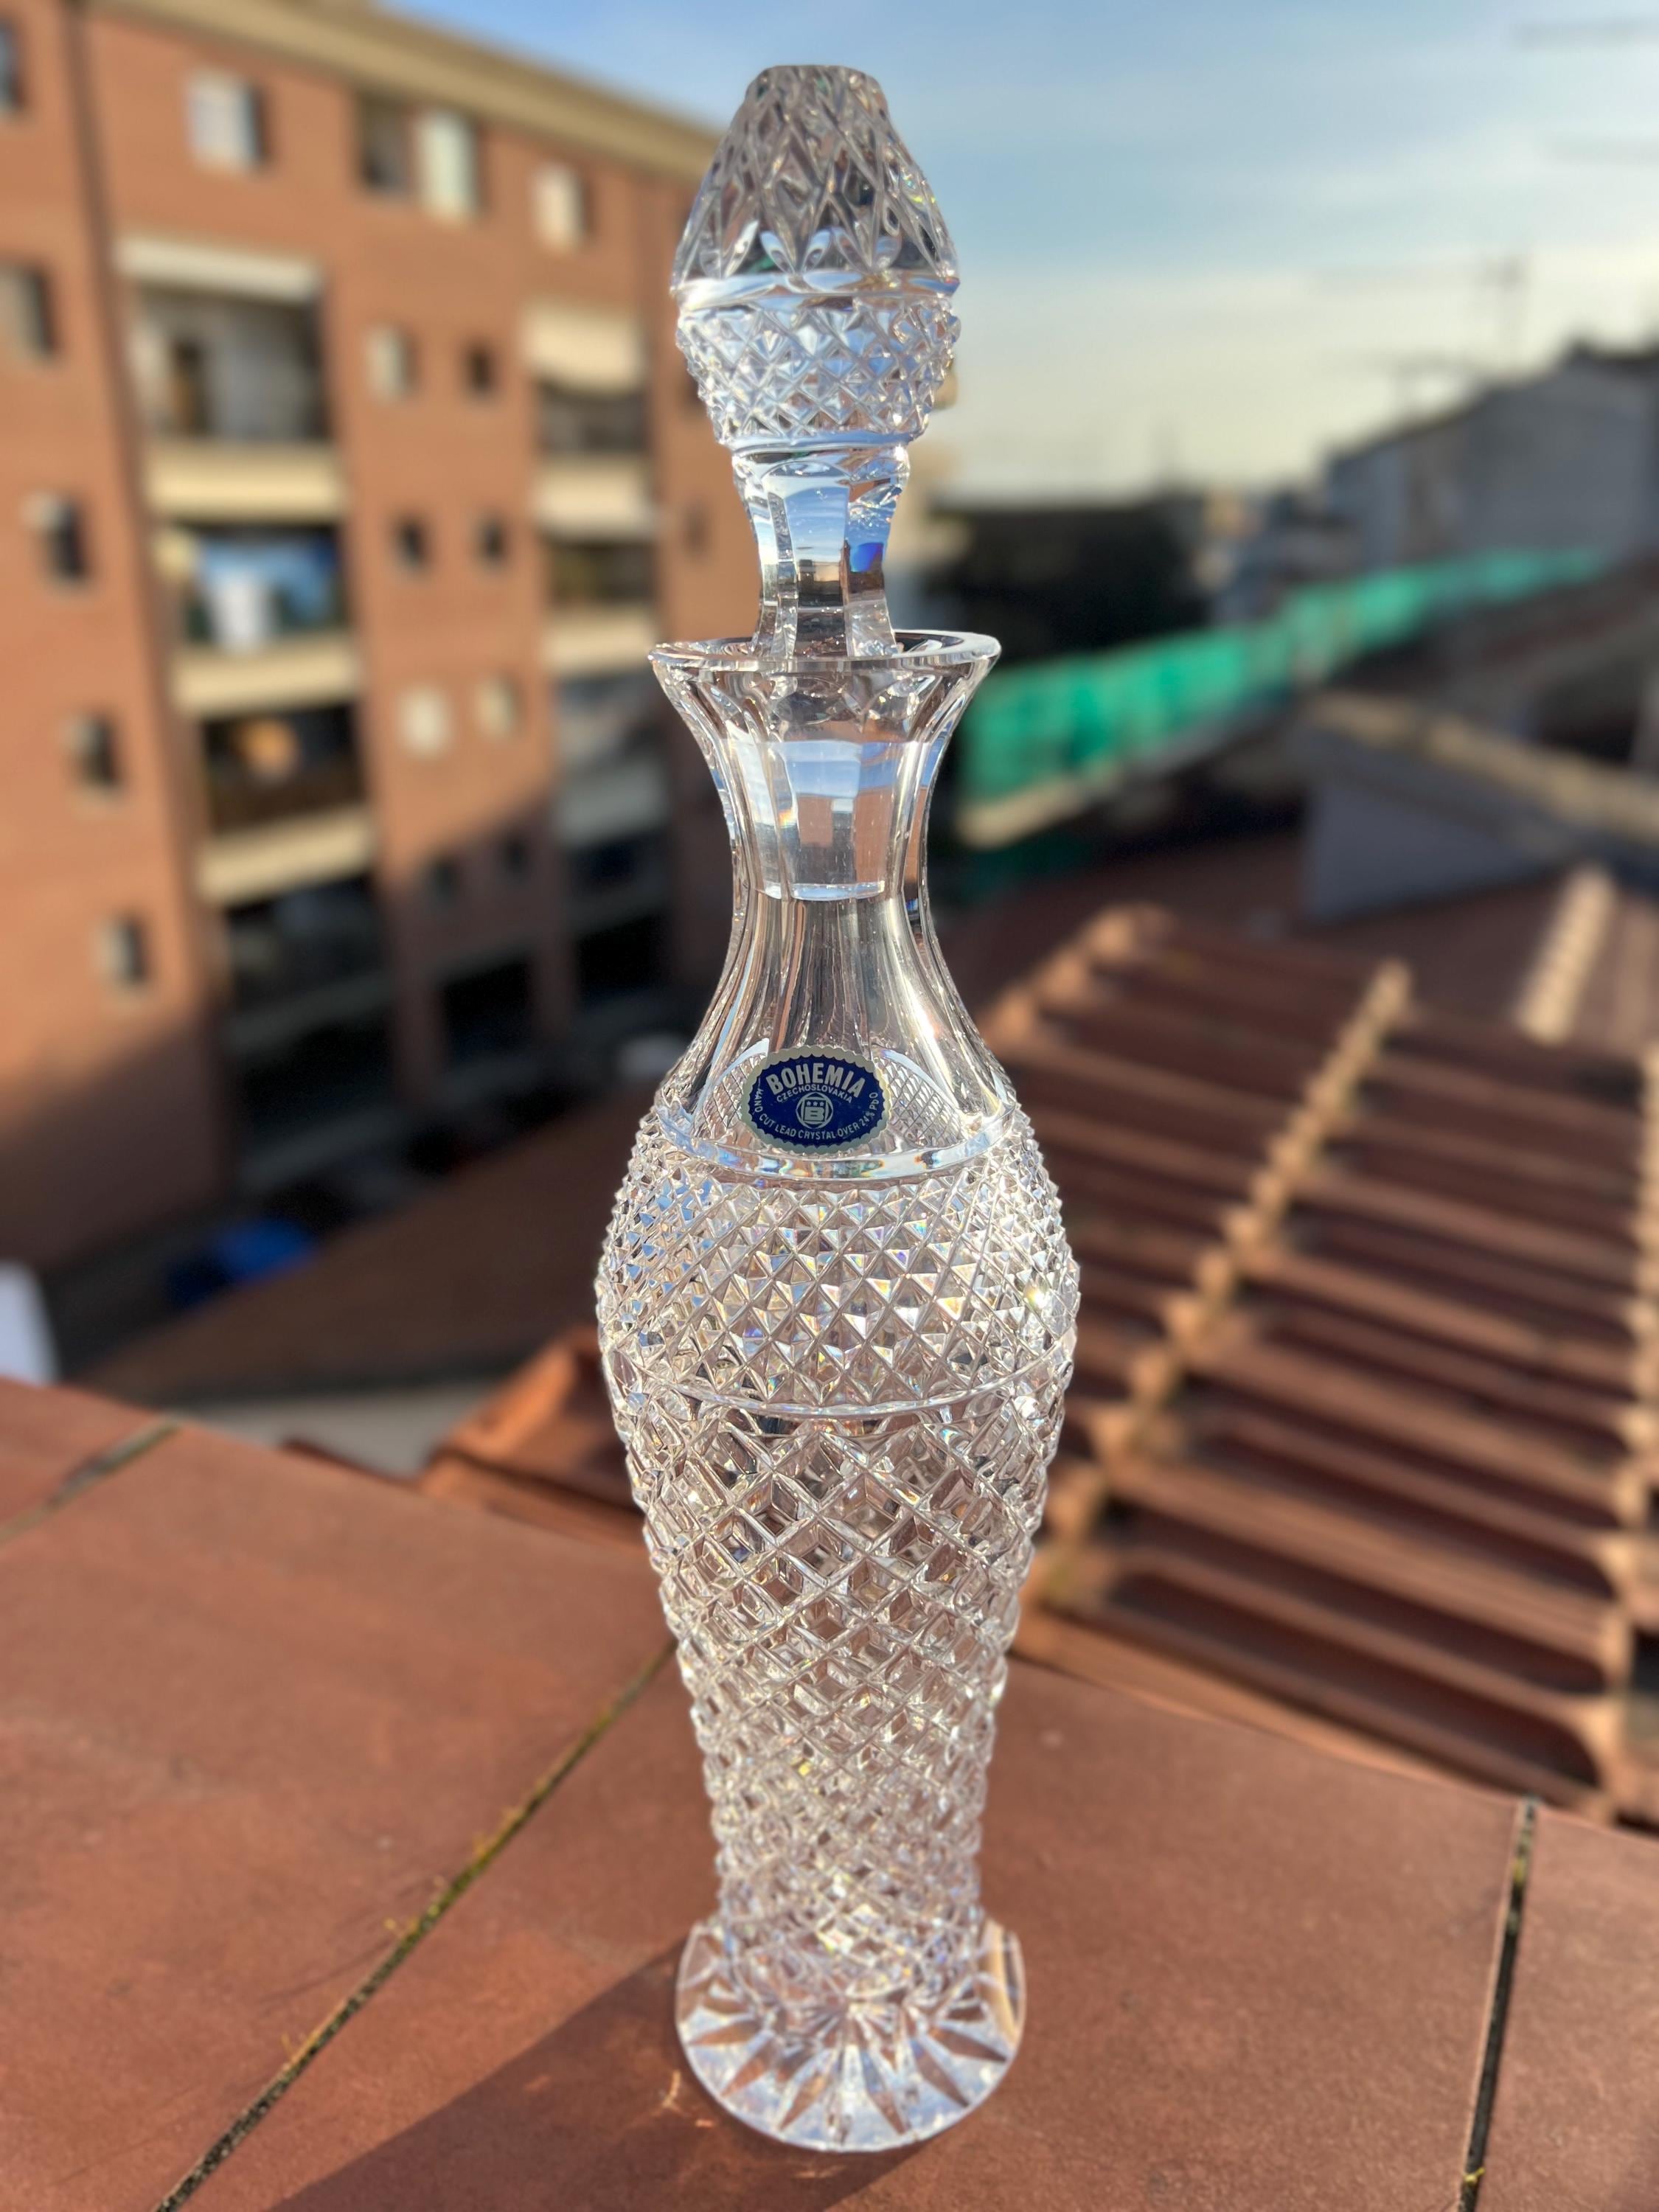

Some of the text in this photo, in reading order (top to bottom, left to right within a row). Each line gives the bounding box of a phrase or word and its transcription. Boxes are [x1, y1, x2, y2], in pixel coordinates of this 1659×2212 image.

[765, 1062, 866, 1098] BOHEMIA
[776, 1084, 853, 1104] CZECHOSLOVAKIA
[754, 1088, 764, 1113] HAND
[759, 1113, 776, 1127] CUT
[774, 1124, 797, 1137] LEAD
[798, 1129, 836, 1140] CRYSTAL
[837, 1121, 860, 1137] OVER
